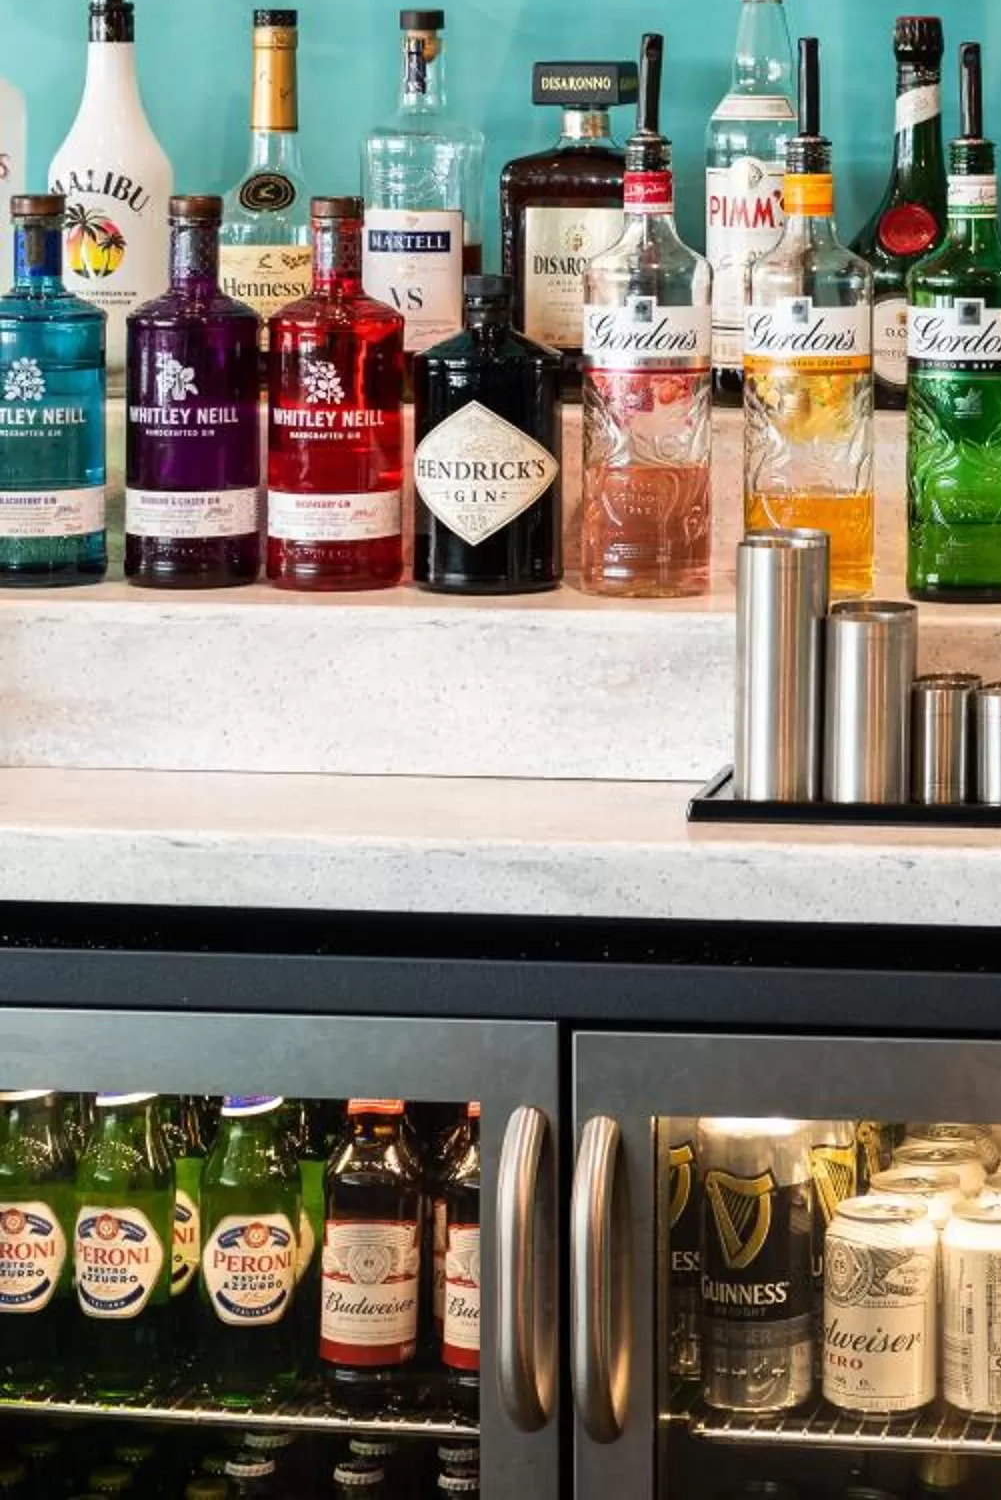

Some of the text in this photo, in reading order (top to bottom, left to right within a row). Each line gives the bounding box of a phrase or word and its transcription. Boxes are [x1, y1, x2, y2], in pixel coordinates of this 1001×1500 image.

[541, 76, 611, 91] DISARONNO
[50, 169, 150, 212] MALIBU
[371, 233, 447, 250] MARTELL
[533, 255, 588, 276] DISARO
[223, 276, 309, 297] Hennessy
[590, 312, 698, 351] Gordon's
[747, 312, 857, 352] Gordon's
[0, 407, 88, 425] TLEY NEILL
[129, 406, 239, 425] WHITLEY NEILL
[273, 407, 384, 427] WHITLEY NEILL
[417, 458, 546, 481] HENDRICK'S
[454, 490, 497, 503] GIN
[0, 1241, 56, 1261] RONI
[77, 1248, 150, 1265] PERONI
[213, 1250, 291, 1273] PERONI
[81, 1274, 139, 1284] AZZURRO
[223, 1281, 283, 1291] AZZURRO
[701, 1276, 789, 1305] GUINNESS
[324, 1292, 414, 1316] Budweiser
[826, 1317, 920, 1354] dweiser
[828, 1353, 863, 1371] ERO
